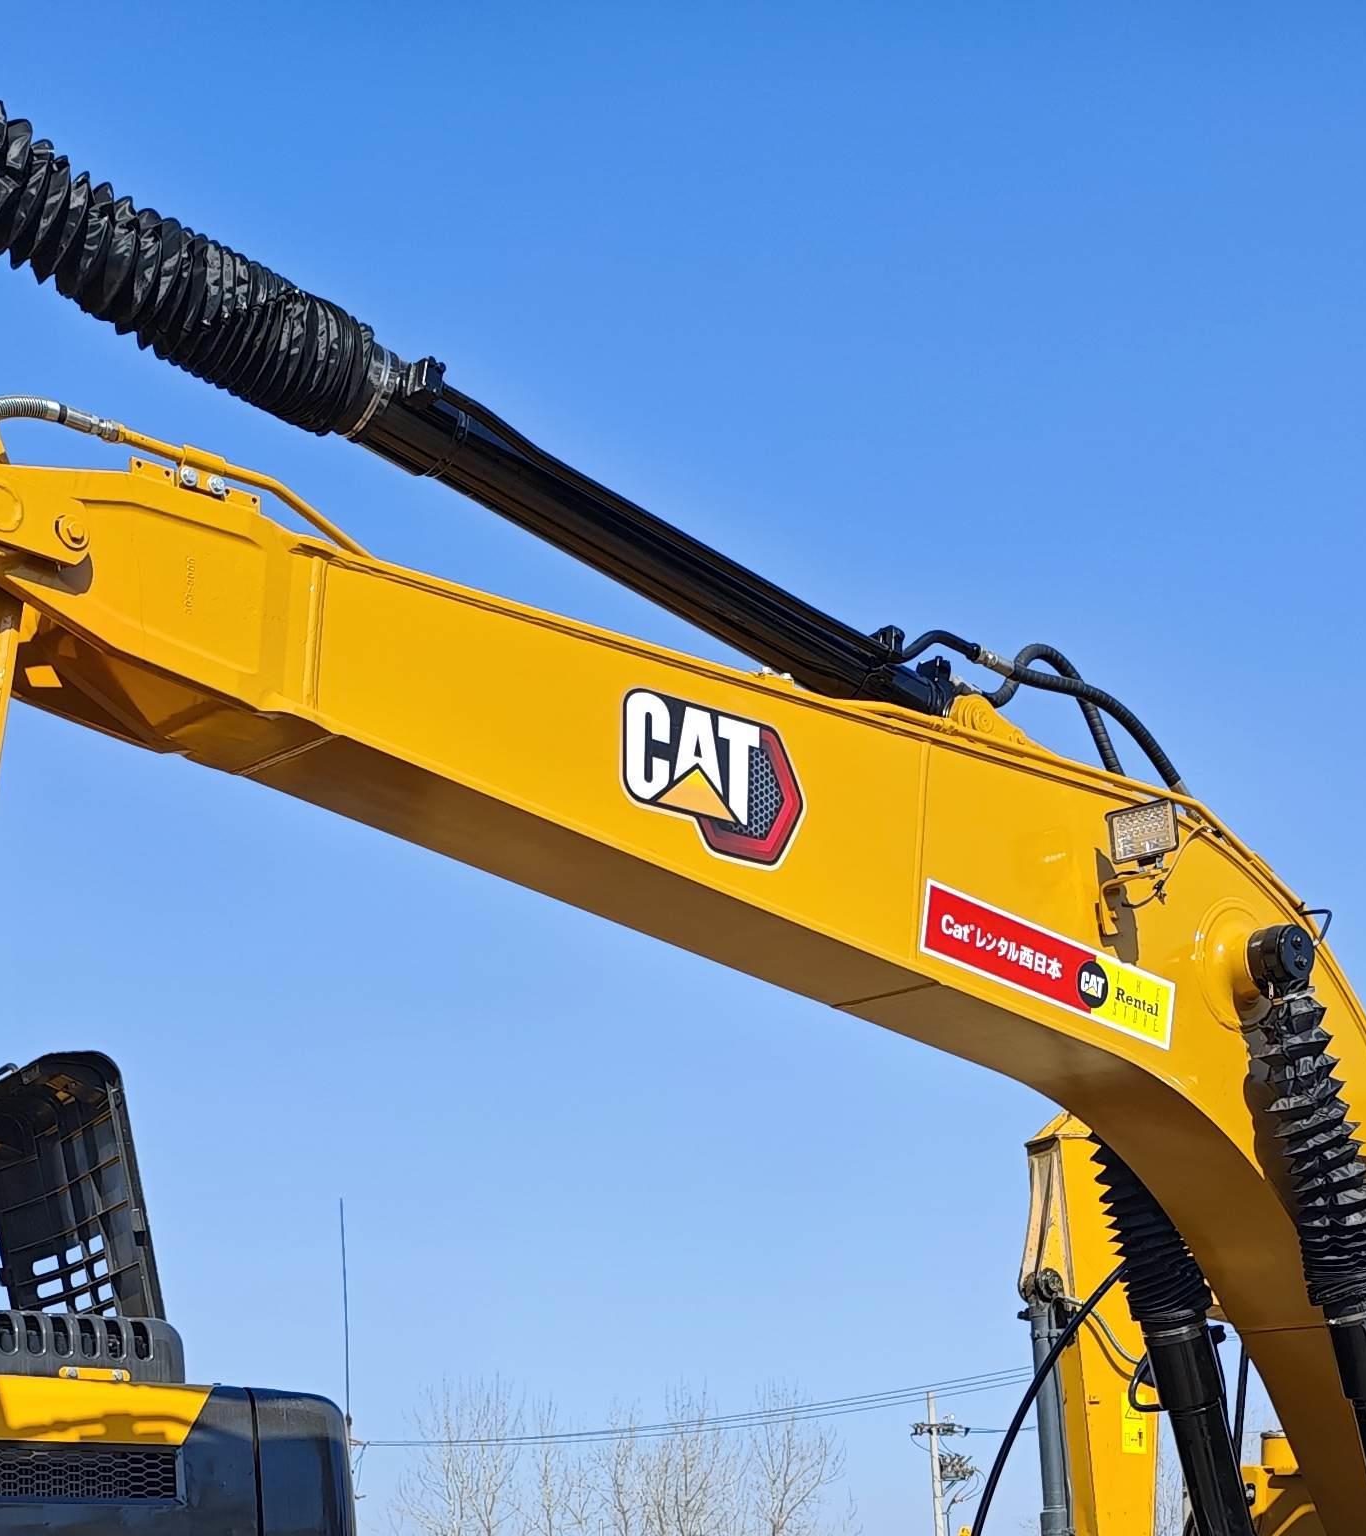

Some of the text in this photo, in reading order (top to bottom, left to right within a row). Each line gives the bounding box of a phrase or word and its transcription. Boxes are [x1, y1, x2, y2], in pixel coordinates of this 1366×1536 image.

[627, 692, 761, 826] CAT
[976, 928, 1063, 980] レンタル西日本
[1080, 971, 1105, 999] CAT
[1115, 986, 1159, 1017] Rental
